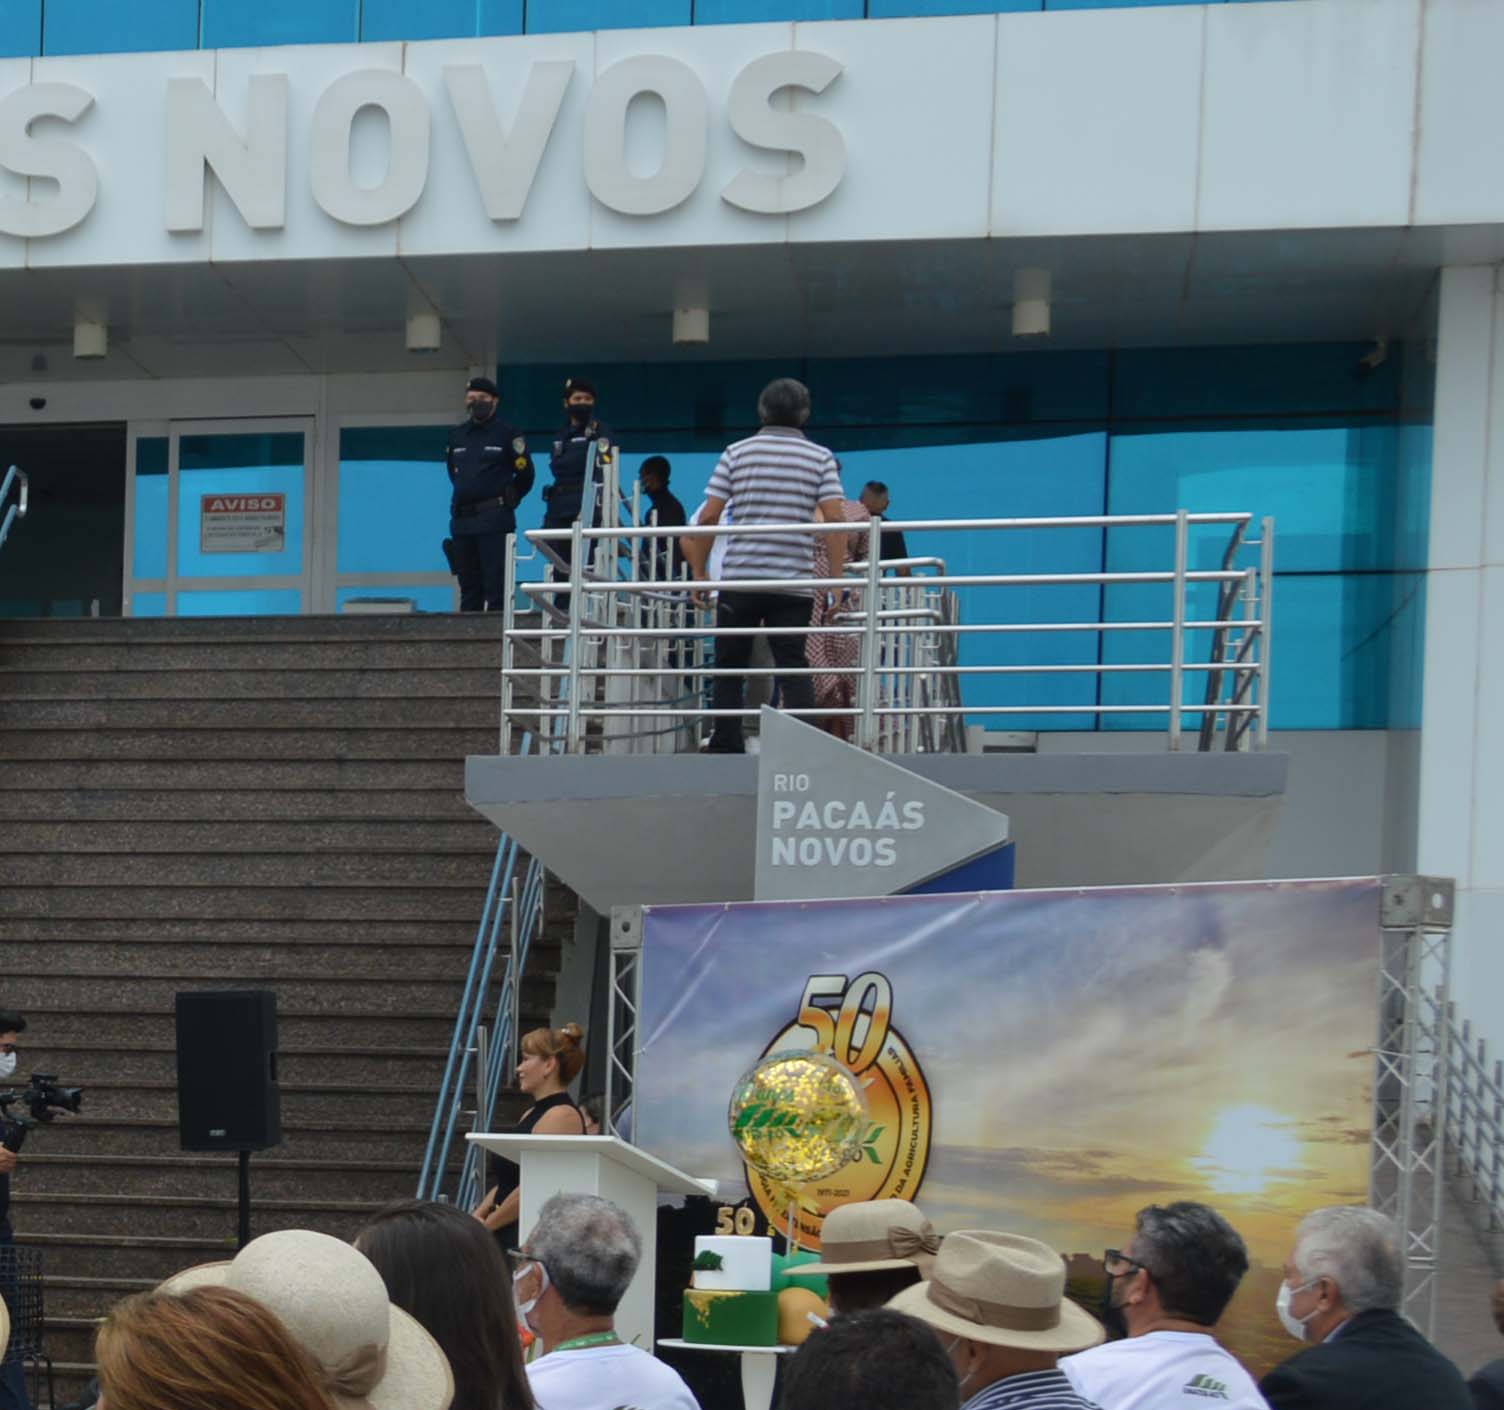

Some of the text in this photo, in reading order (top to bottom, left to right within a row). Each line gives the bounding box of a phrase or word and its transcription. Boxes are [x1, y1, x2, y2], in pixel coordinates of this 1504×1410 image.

[165, 48, 848, 234] NOVOS
[210, 498, 276, 511] AVISO
[773, 773, 810, 793] RIO
[772, 790, 925, 831] PACAÁS
[771, 837, 897, 867] NOVOS
[797, 970, 894, 1077] 50
[715, 1206, 756, 1236] 50
